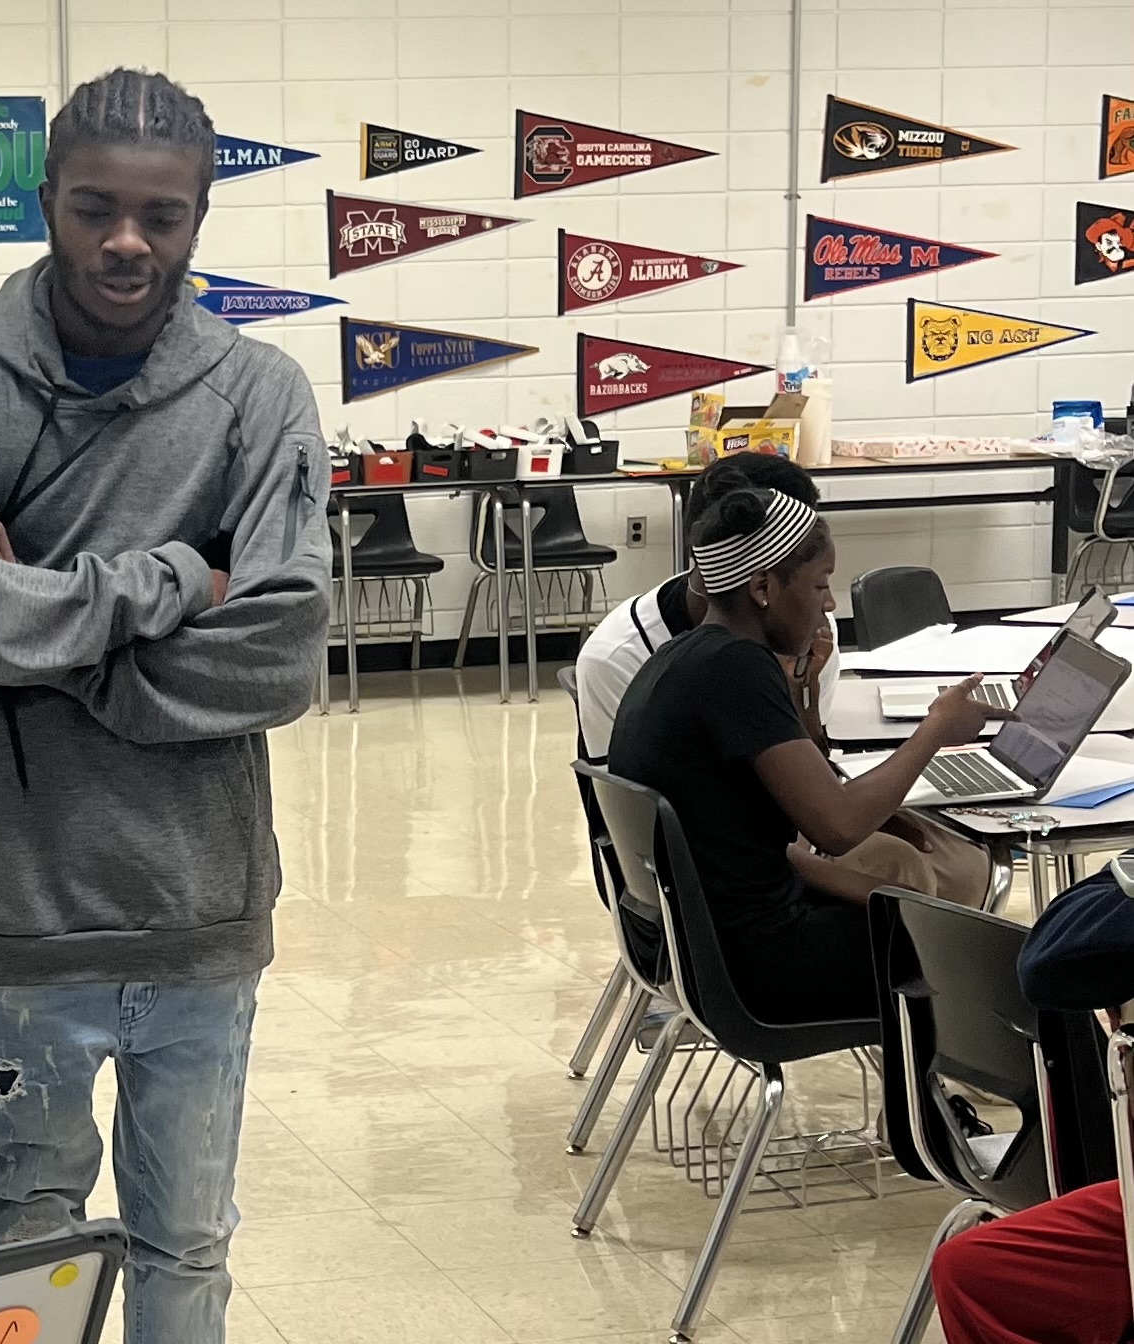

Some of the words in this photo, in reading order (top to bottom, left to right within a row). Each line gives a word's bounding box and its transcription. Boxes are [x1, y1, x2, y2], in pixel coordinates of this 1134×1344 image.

[374, 140, 397, 149] ARMY
[403, 138, 420, 150] GO
[898, 130, 945, 144] MIZZOU
[403, 145, 459, 162] GUARD
[576, 142, 606, 152] SOUTH
[607, 142, 652, 153] CAROLINA
[897, 144, 943, 159] TIGERS
[576, 154, 652, 167] GAMECOCKS
[7, 196, 18, 208] be
[351, 223, 394, 241] STATE
[813, 234, 848, 266] Ole
[848, 234, 902, 266] Miss
[629, 263, 689, 282] ALABAMA
[823, 266, 881, 281] REBELS
[221, 295, 311, 312] JAYHAWKS
[966, 329, 994, 344] NC
[999, 327, 1041, 344] A&T
[589, 382, 648, 396] RAZORBACKS
